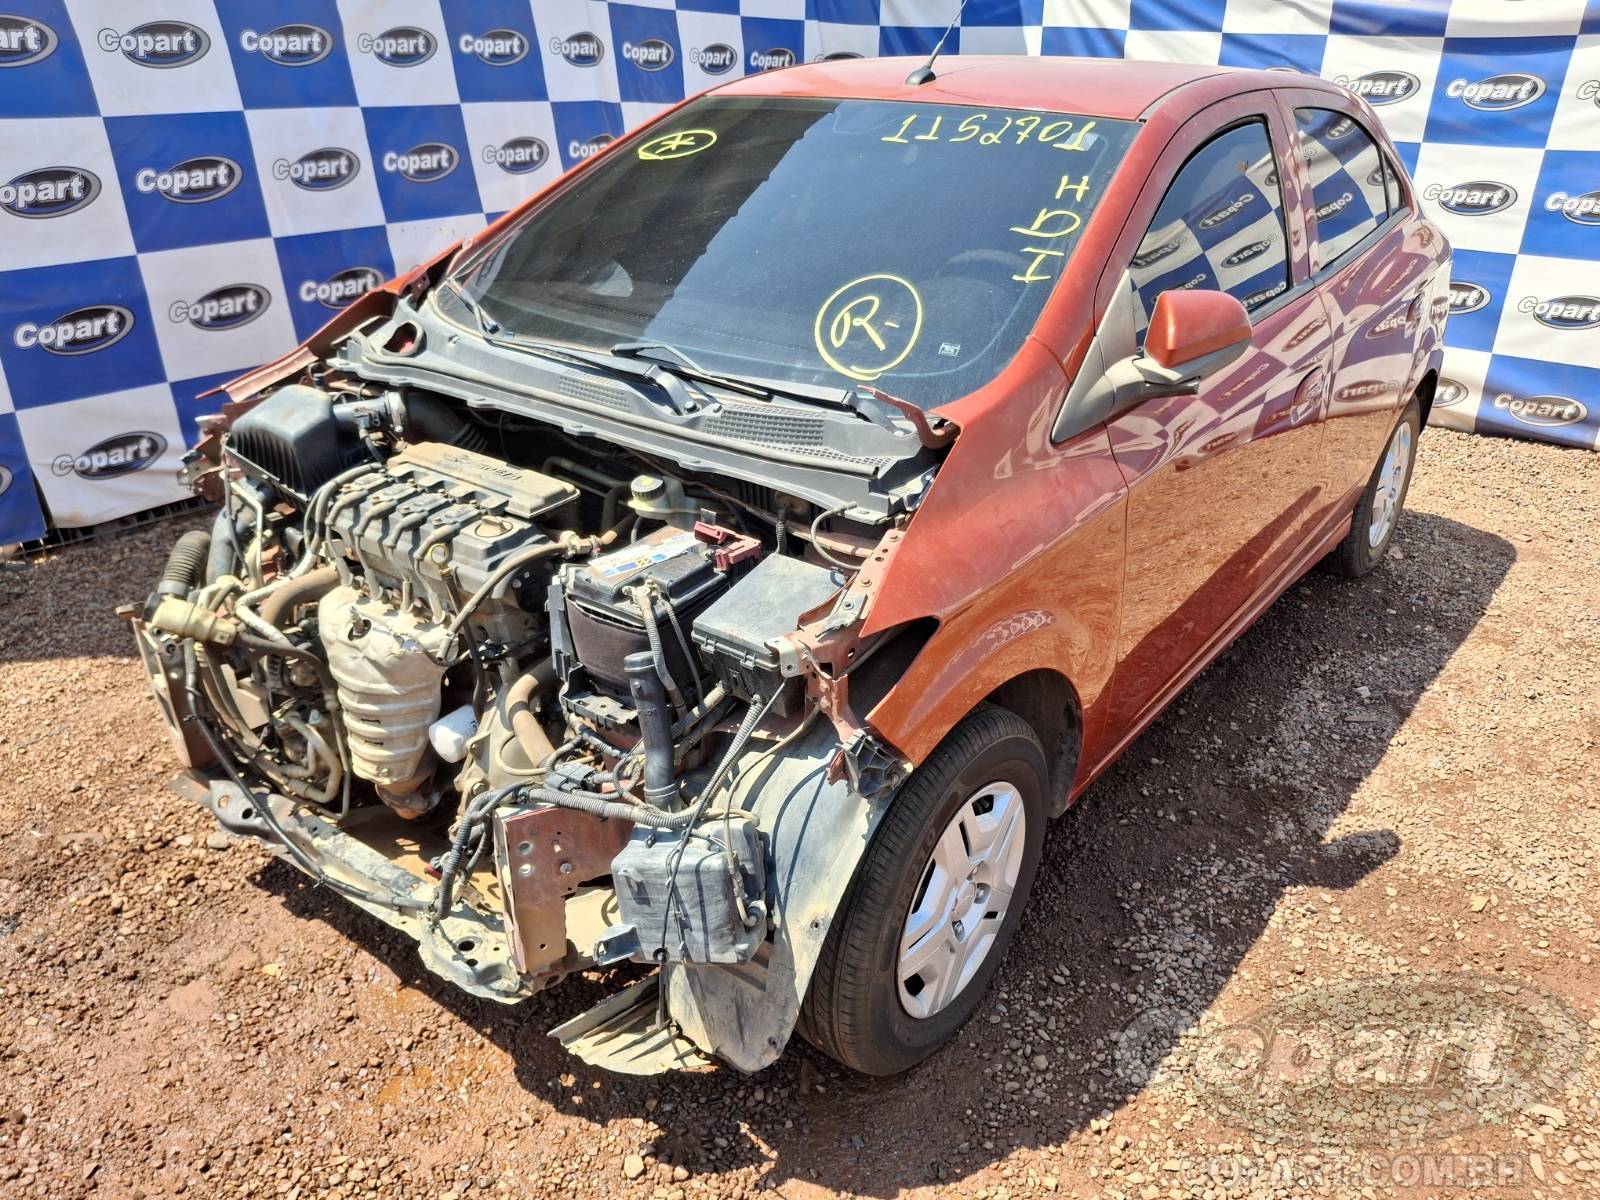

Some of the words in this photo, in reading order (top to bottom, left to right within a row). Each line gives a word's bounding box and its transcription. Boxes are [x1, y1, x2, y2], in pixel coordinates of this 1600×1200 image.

[0, 25, 41, 52] art
[98, 26, 195, 57] Copart
[241, 29, 321, 56] Copart
[358, 33, 426, 58] Copart
[459, 34, 522, 58] Copart
[622, 42, 668, 64] Copart
[690, 48, 731, 69] Copart
[750, 51, 790, 70] Copart
[1446, 78, 1537, 102] Copart
[483, 145, 540, 170] Copart
[569, 141, 609, 158] Cop
[273, 154, 349, 183] Copart
[384, 151, 449, 175] Copart
[0, 172, 84, 210] opart
[137, 161, 229, 195] Copart
[1423, 183, 1508, 208] Copart
[1544, 191, 1600, 217] Cop
[300, 273, 375, 303] Copart
[169, 290, 259, 323] Copart
[1518, 296, 1600, 322] Copart
[14, 312, 120, 349] Copart
[1494, 393, 1578, 419] Copart
[51, 438, 153, 477] Copart
